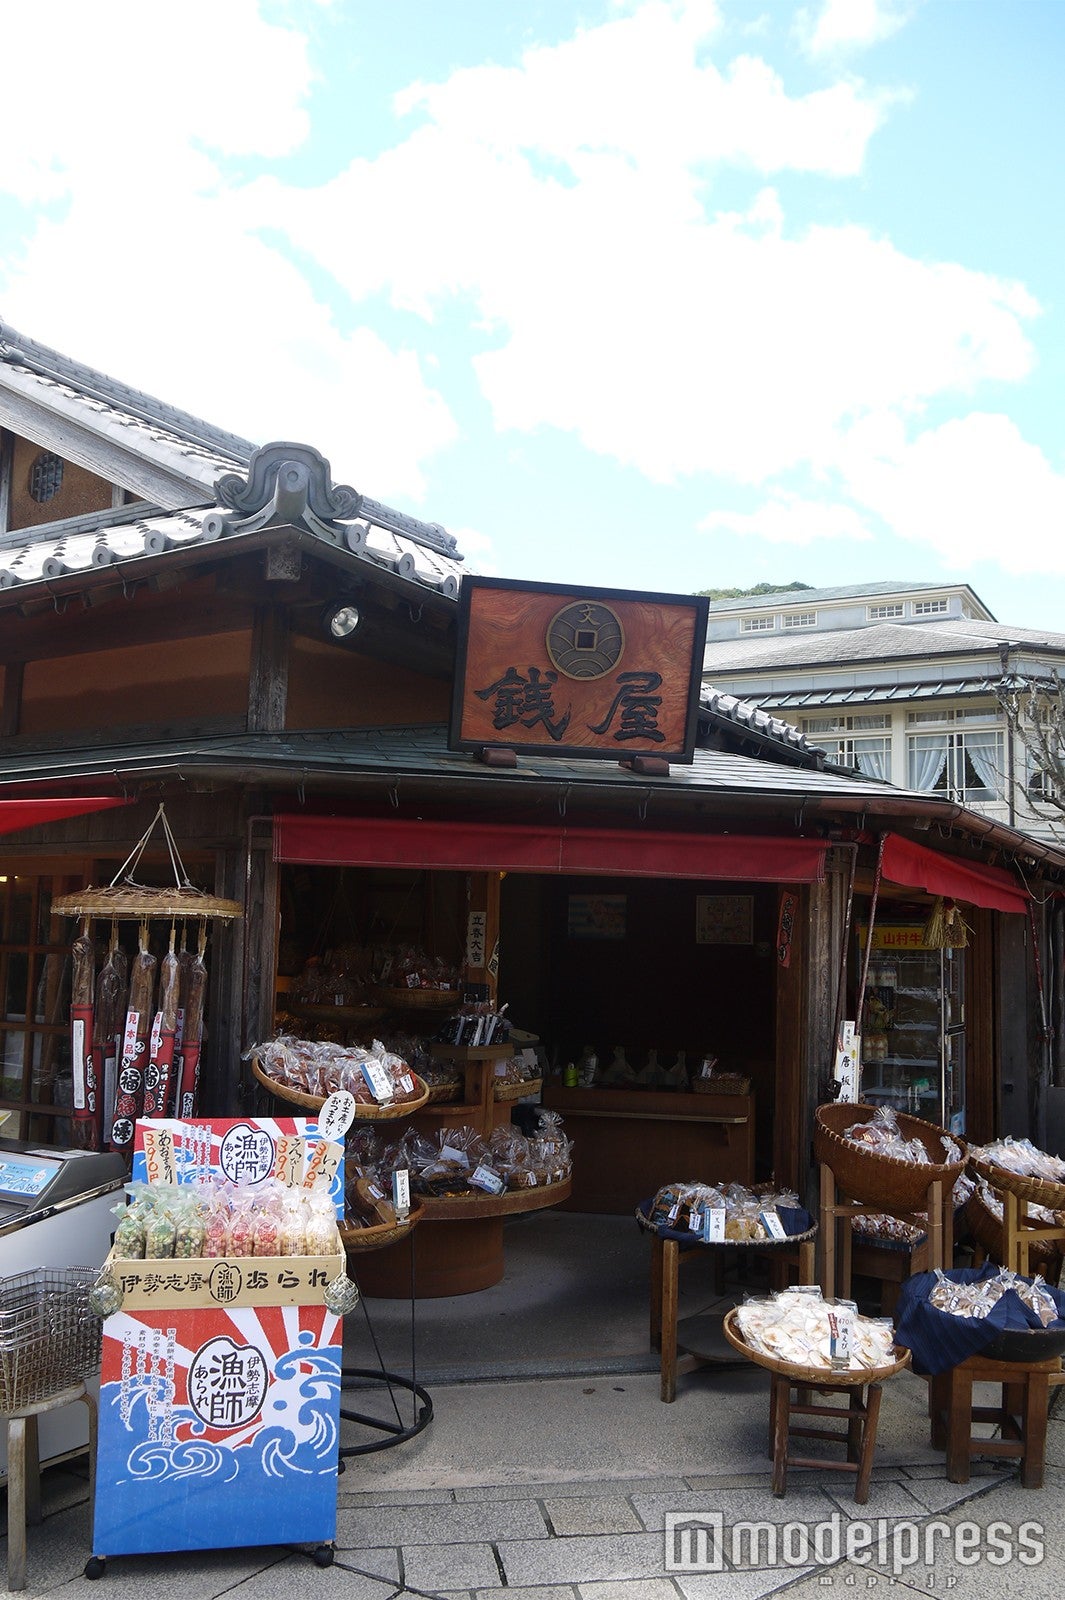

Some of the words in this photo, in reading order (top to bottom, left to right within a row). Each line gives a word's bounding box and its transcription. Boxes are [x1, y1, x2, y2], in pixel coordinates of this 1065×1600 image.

[579, 604, 602, 627] 文
[474, 666, 666, 742] 銭屋
[470, 915, 484, 962] 立春大吉
[124, 1013, 137, 1055] 見本品
[224, 1142, 235, 1171] あられ
[235, 1133, 259, 1181] 漁師
[259, 1137, 269, 1172] 伊勢志摩
[120, 1272, 207, 1293] 伊勢志摩
[217, 1269, 233, 1300] 漁師
[246, 1268, 330, 1290] あられ
[194, 1364, 210, 1409] あられ
[209, 1351, 247, 1424] 漁師
[245, 1355, 261, 1409] 伊勢志摩
